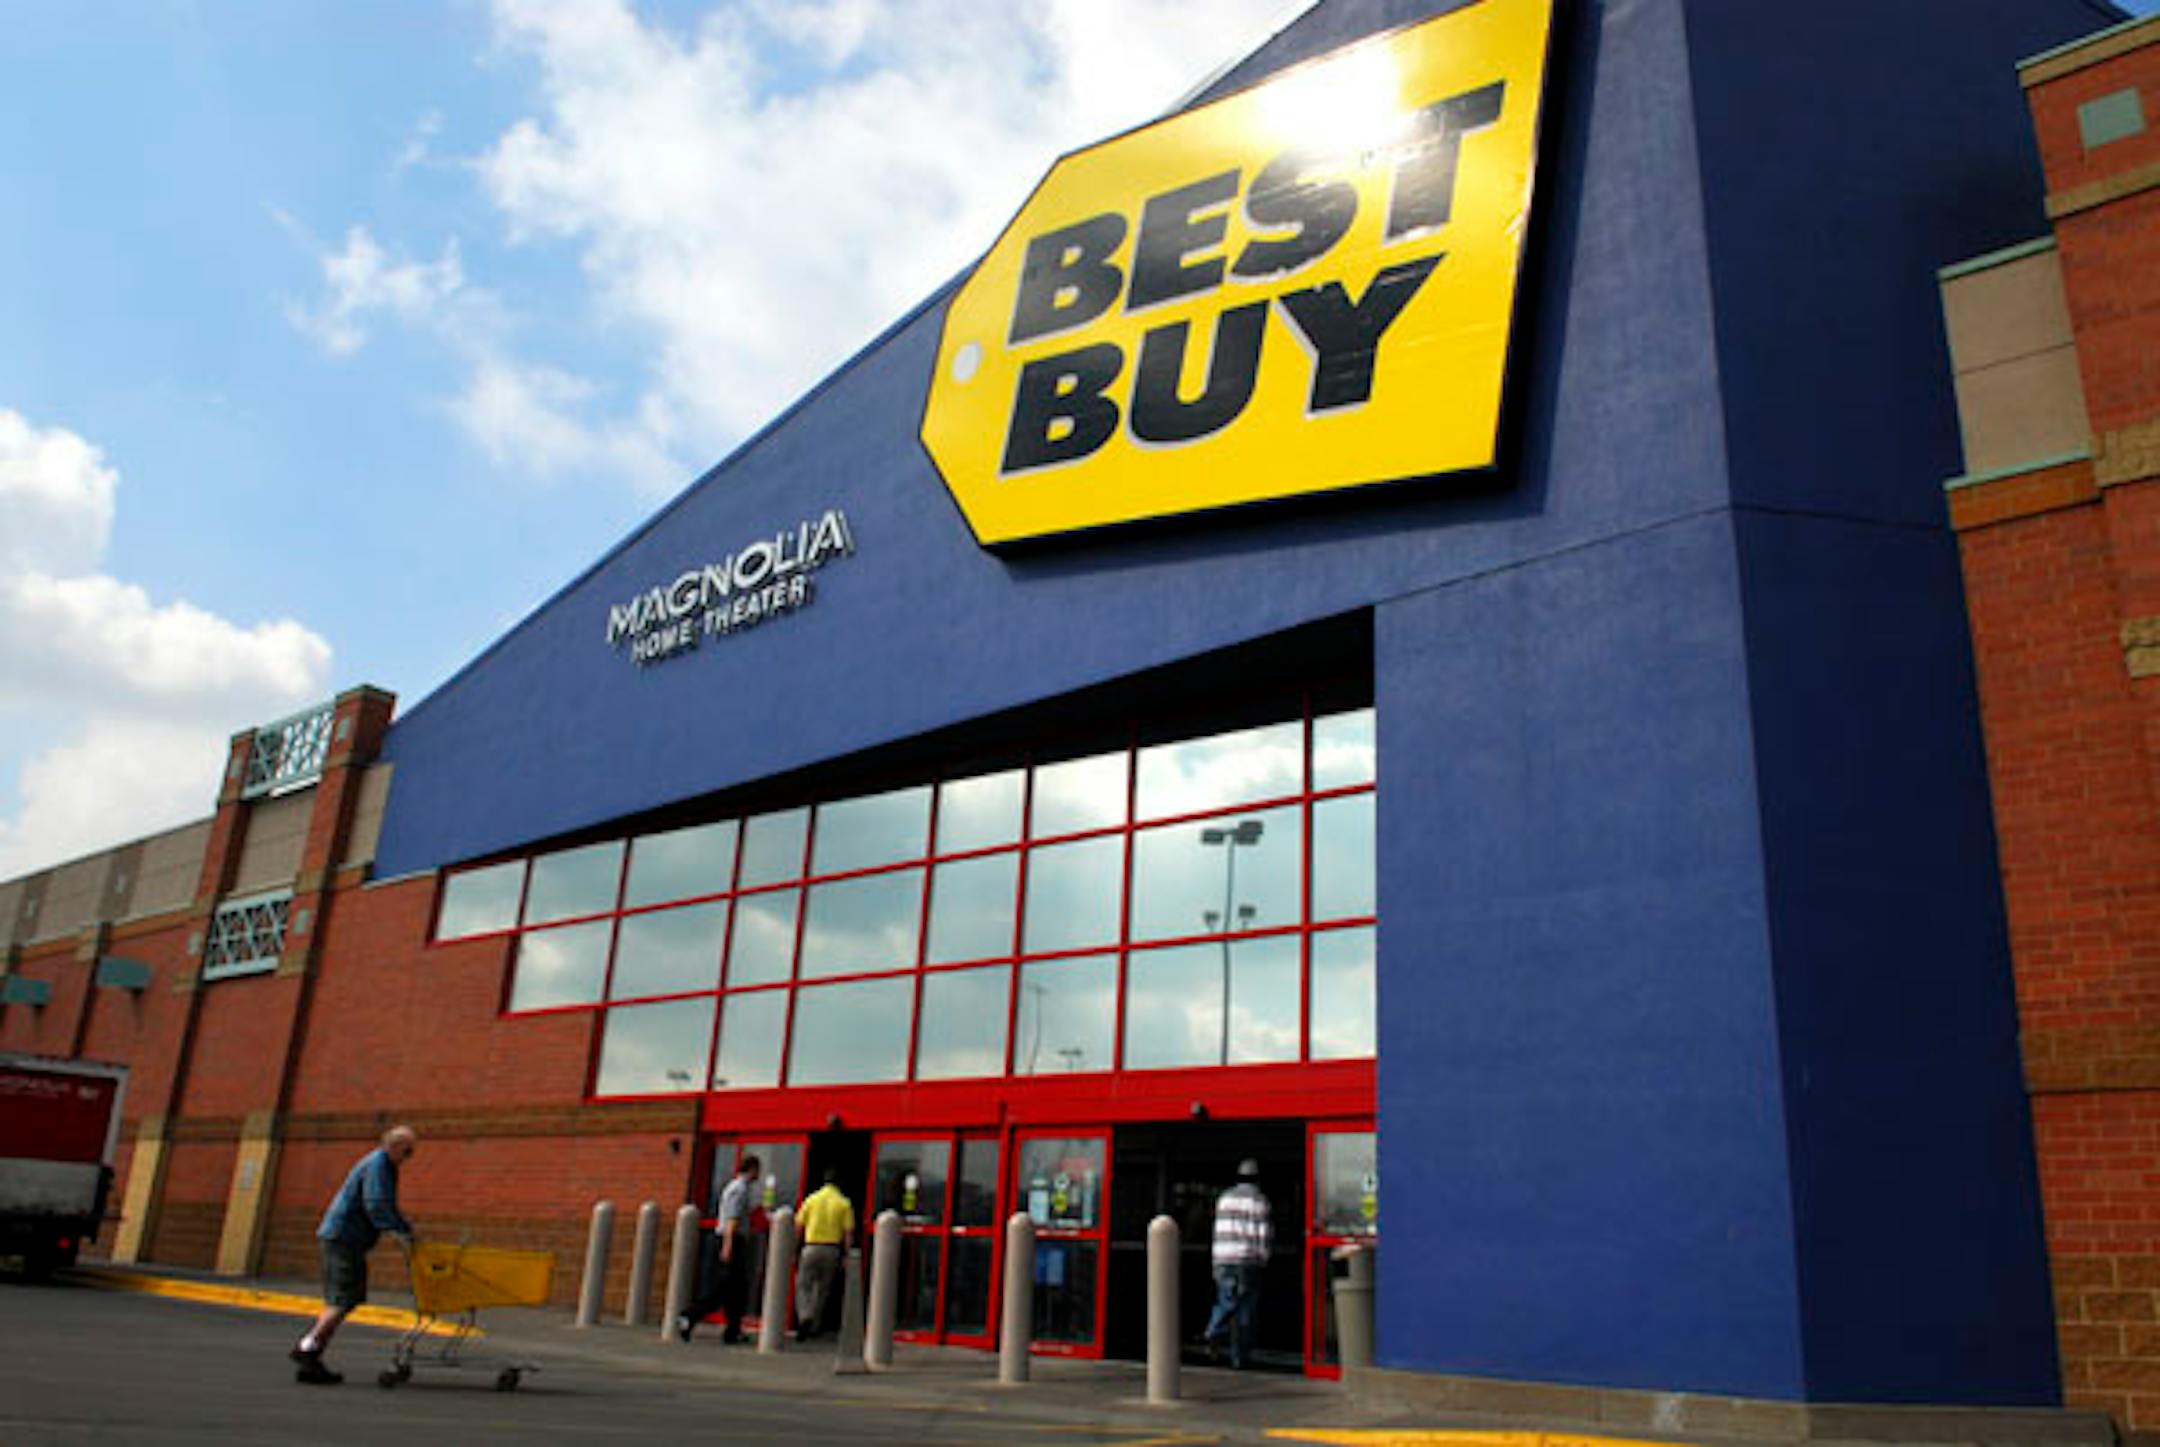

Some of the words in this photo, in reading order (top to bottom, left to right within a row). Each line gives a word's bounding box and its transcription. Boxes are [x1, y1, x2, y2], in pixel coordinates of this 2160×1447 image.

[1007, 79, 1506, 348] BEST
[999, 252, 1447, 477] BUY
[607, 510, 855, 645] MAGNOLIA
[631, 617, 697, 666] HOME
[703, 573, 812, 636] THEATER
